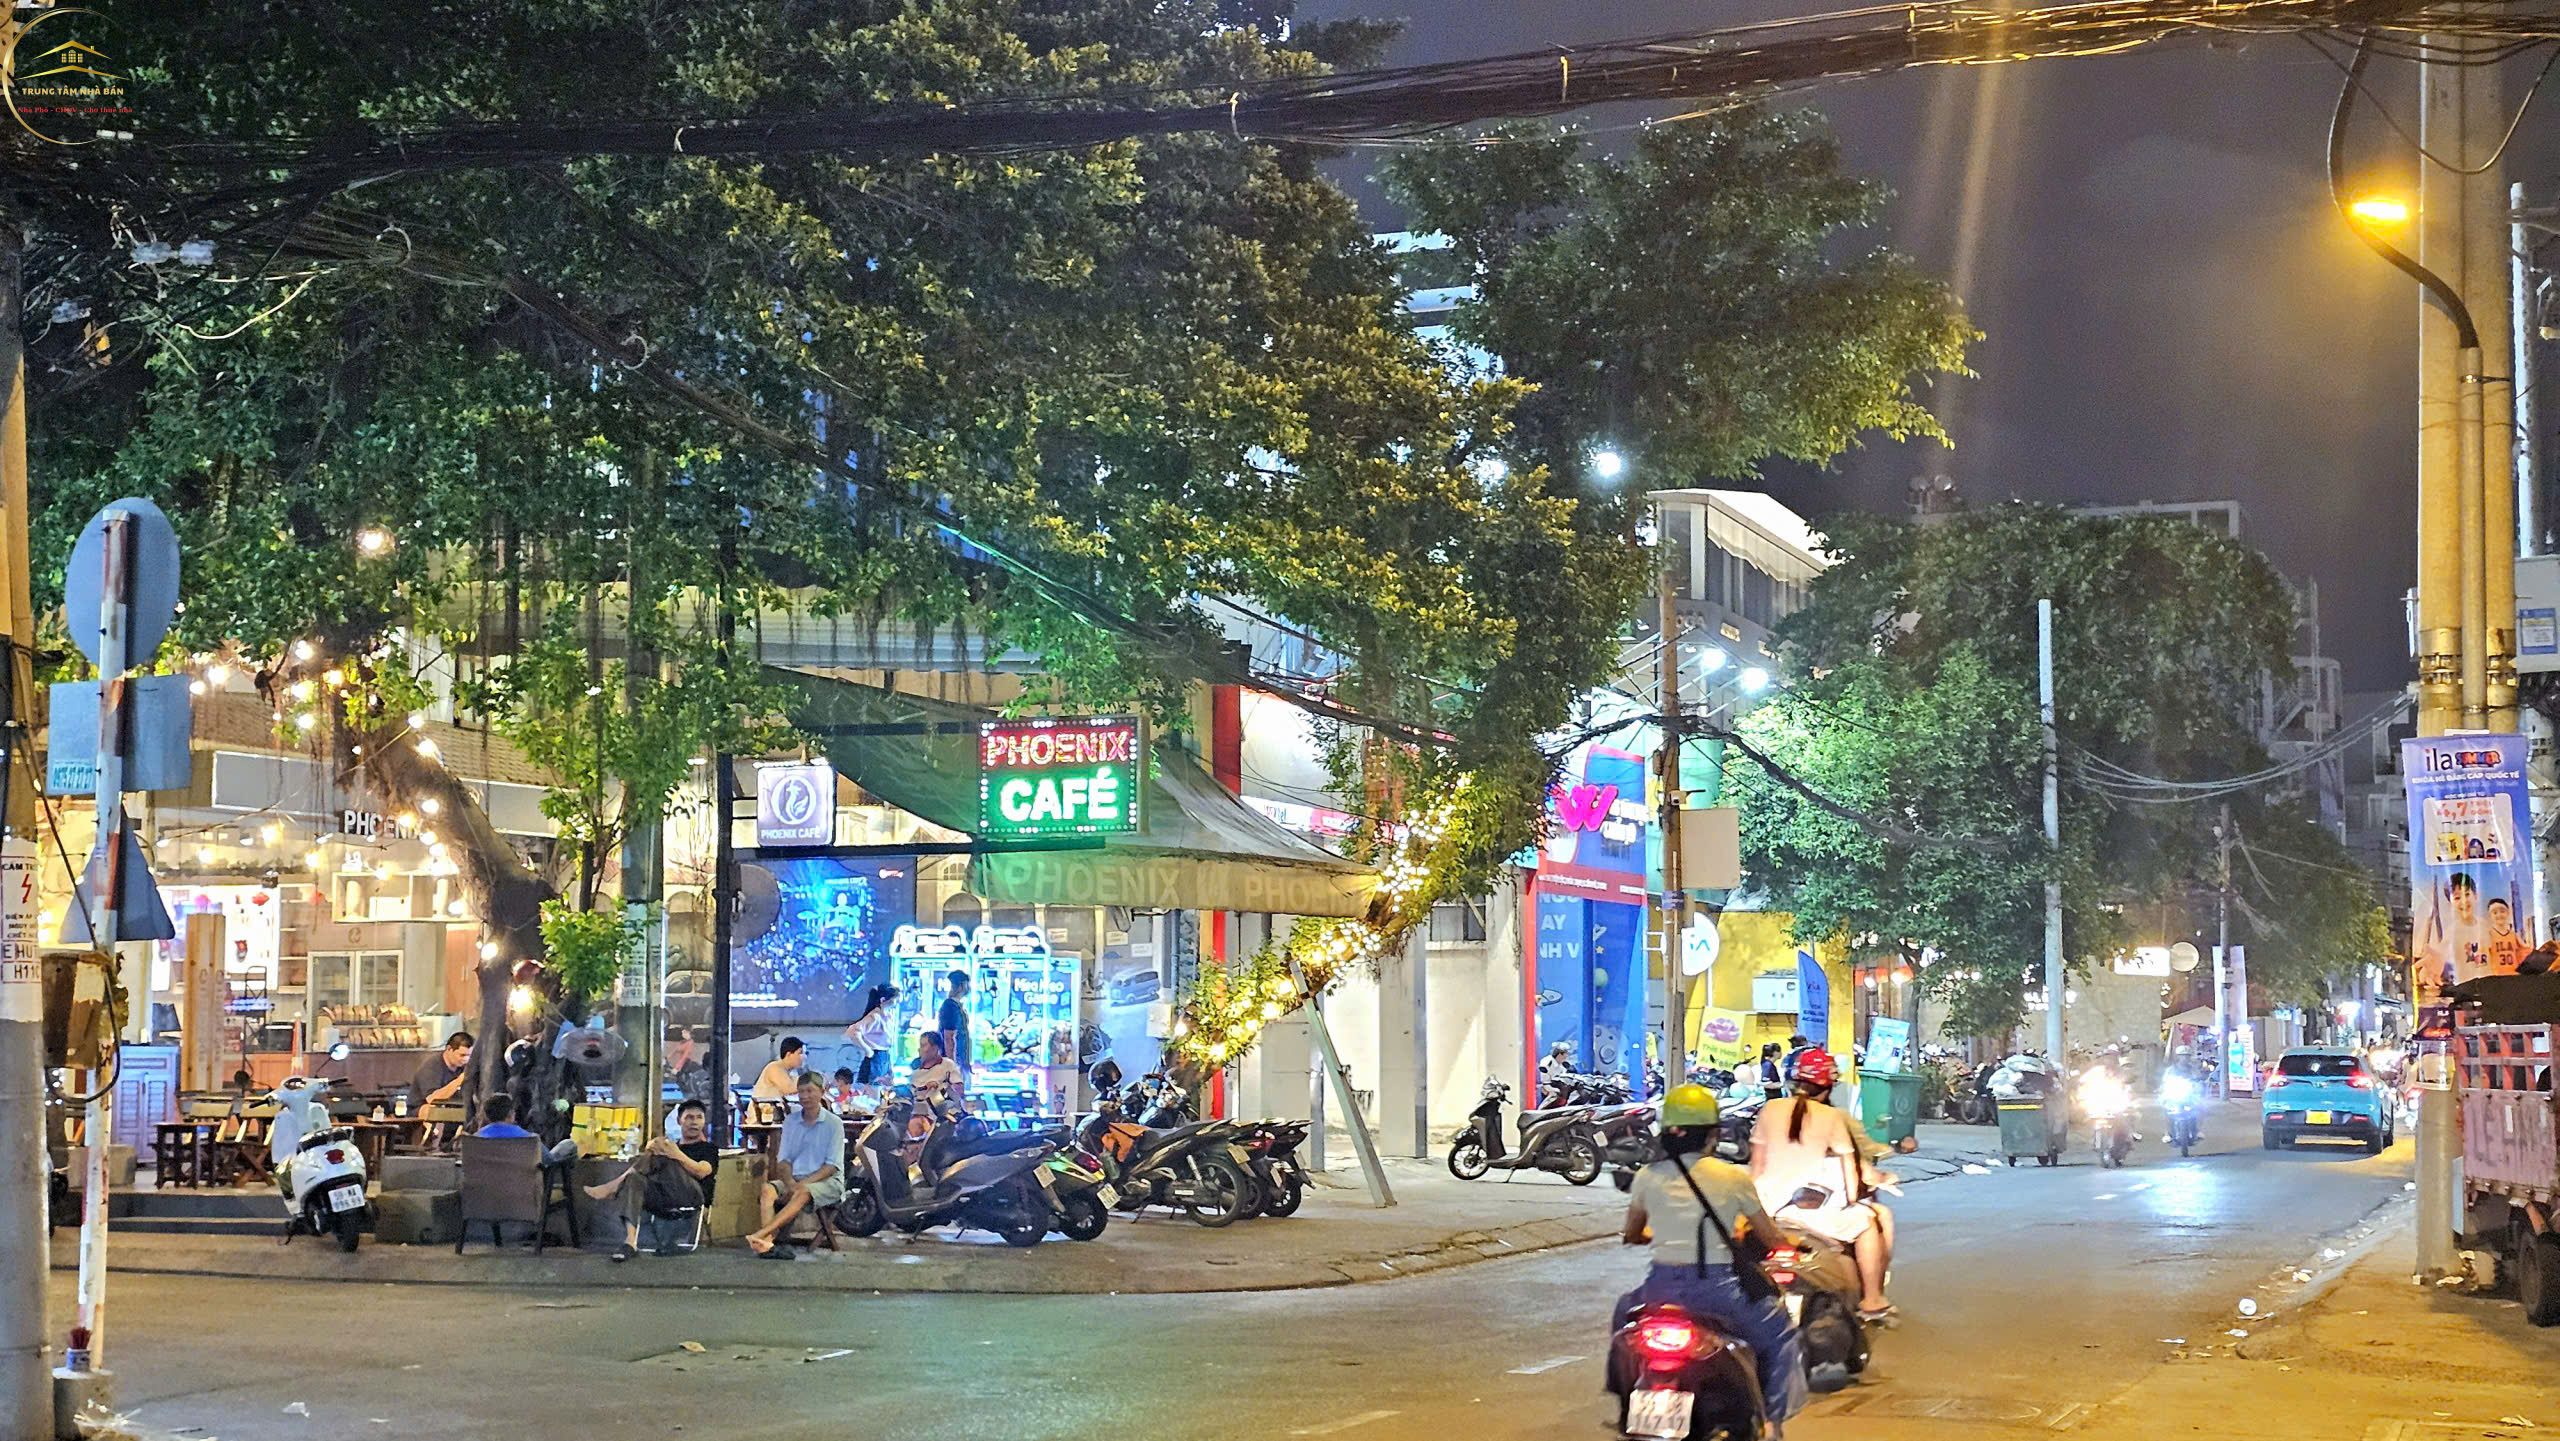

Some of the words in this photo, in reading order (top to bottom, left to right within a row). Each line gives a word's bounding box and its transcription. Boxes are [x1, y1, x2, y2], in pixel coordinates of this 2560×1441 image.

[986, 730, 1129, 766] PHOENIX
[2424, 747, 2454, 772] ila
[1000, 766, 1120, 822] CAFÉ
[760, 828, 798, 839] PHOENIX
[798, 825, 821, 838] CAFÉ
[1003, 862, 1182, 903] PHOENIX
[2499, 953, 2513, 966] 30
